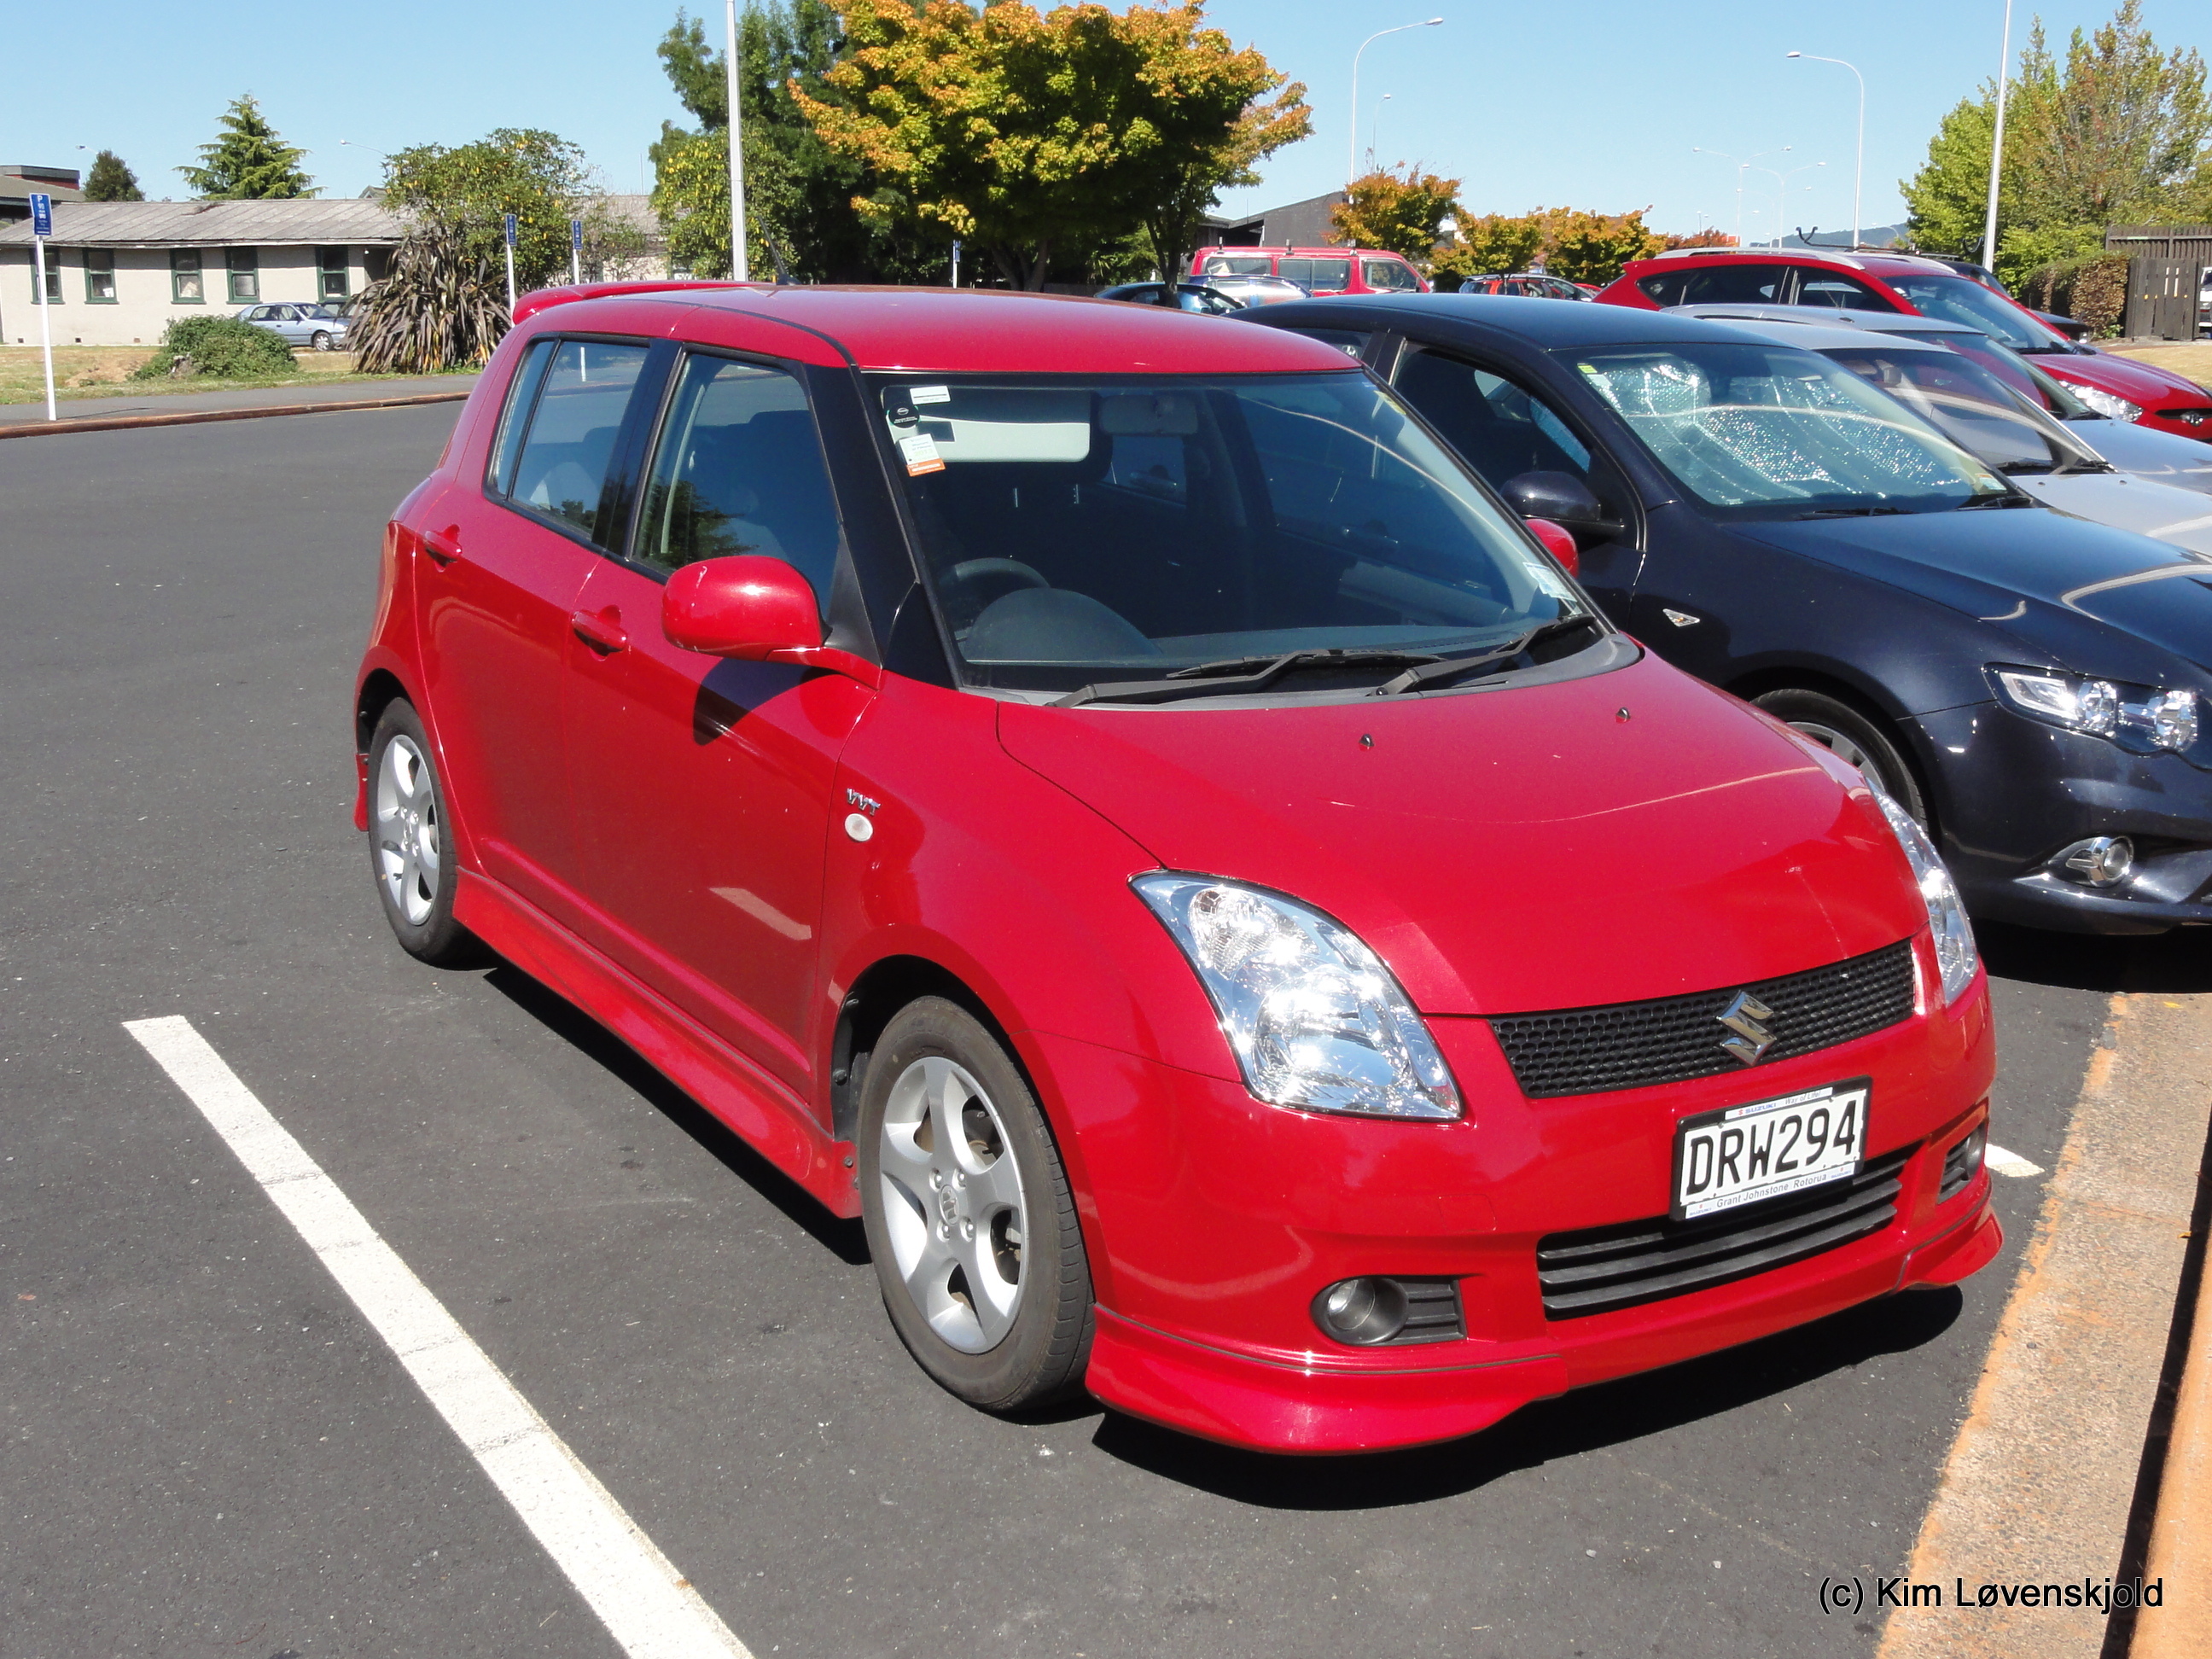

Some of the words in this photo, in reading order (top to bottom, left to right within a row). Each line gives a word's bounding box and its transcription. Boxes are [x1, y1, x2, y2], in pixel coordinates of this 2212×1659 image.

[847, 788, 881, 817] VVT
[1745, 1103, 1776, 1114] SUZUKI
[1784, 1097, 1797, 1105] Way
[1800, 1093, 1807, 1102] of
[1685, 1100, 1857, 1196] DRW294
[1716, 1194, 1742, 1208] Grant
[1743, 1182, 1789, 1202] Johnstone
[1793, 1173, 1827, 1189] Rotorua
